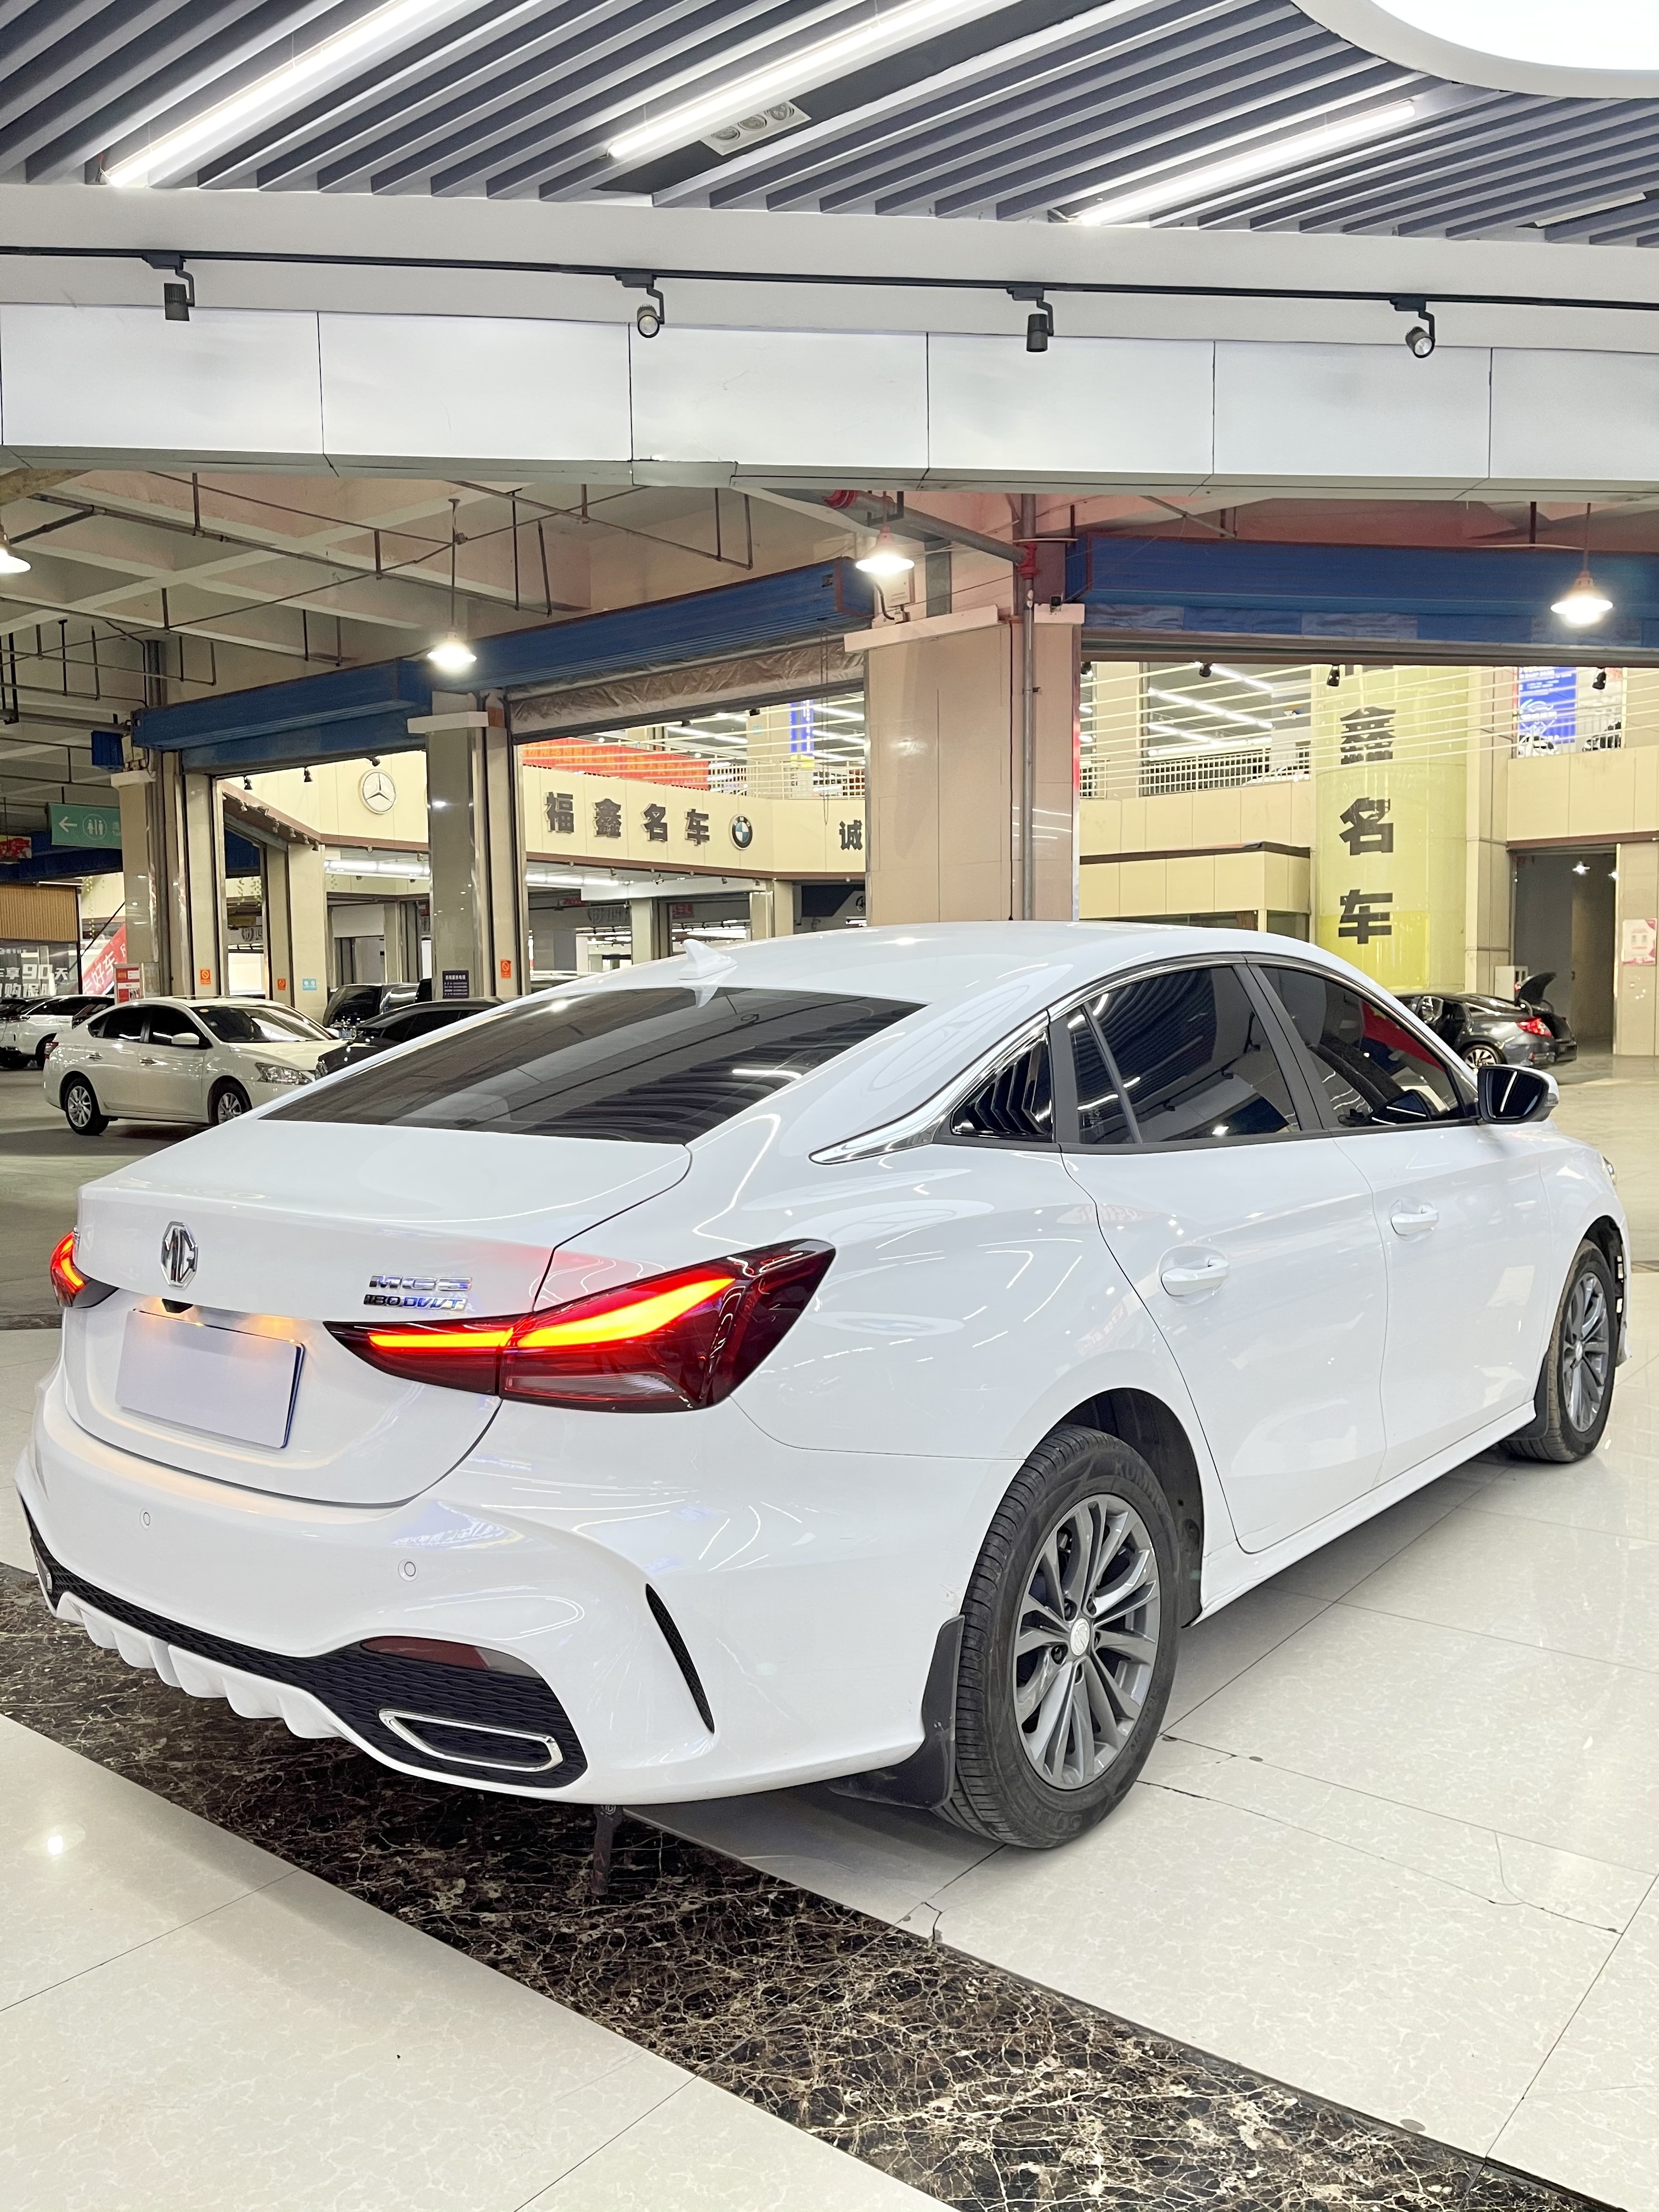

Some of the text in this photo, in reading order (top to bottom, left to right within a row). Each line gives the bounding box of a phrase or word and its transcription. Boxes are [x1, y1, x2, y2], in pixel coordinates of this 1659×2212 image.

[544, 791, 710, 846] 福鑫名车
[1339, 665, 1396, 944] 鑫名车
[839, 819, 863, 850] 诚
